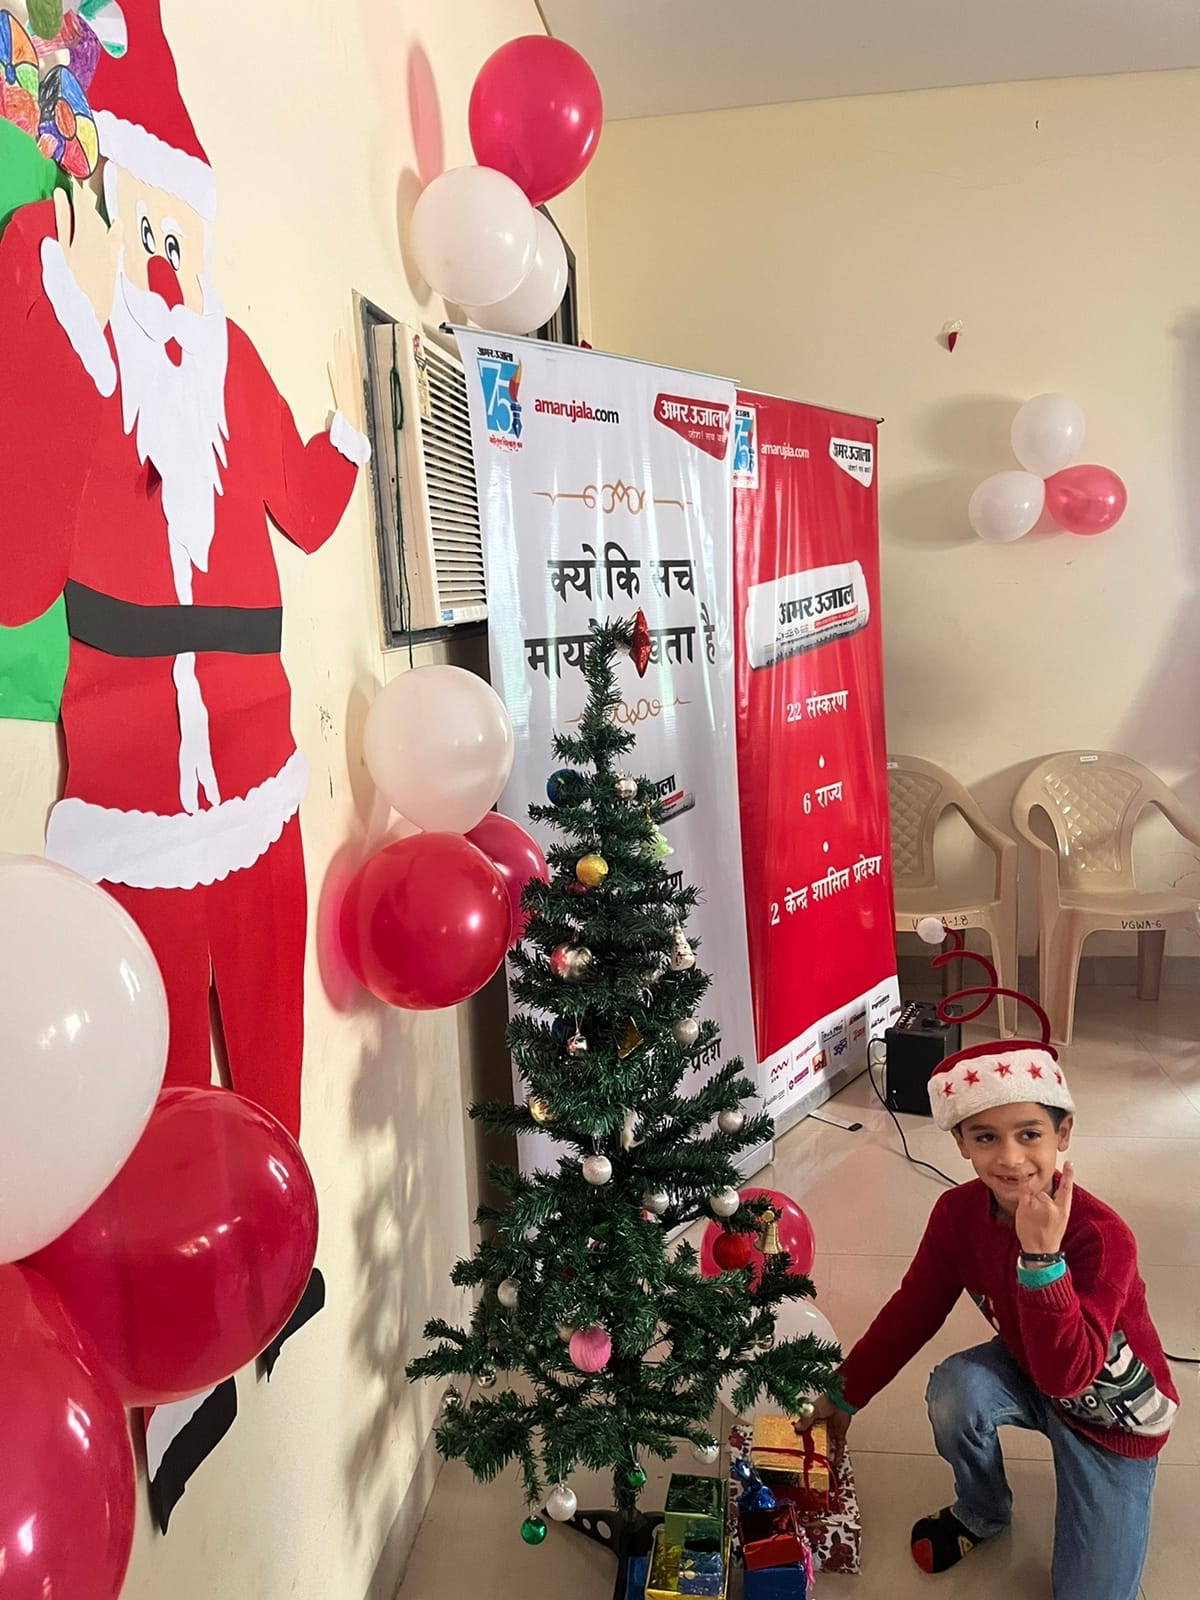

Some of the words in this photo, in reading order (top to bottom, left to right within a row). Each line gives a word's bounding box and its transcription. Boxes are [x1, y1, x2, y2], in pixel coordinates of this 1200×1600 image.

[534, 398, 620, 424] amarujala.com
[660, 400, 688, 422] अमर
[689, 405, 727, 428] उजाला
[760, 442, 810, 460] amarujala.com
[833, 442, 848, 459] अमर
[848, 446, 871, 462] उजाला
[778, 596, 814, 625] अमर
[700, 602, 716, 665] है
[786, 702, 802, 723] 22
[805, 690, 848, 719] संस्करण
[802, 792, 812, 815] 6
[815, 781, 843, 808] राज्य
[770, 902, 781, 926] 2
[783, 887, 809, 915] केन्द्र
[811, 866, 850, 902] शासित
[852, 853, 882, 884] प्रदेश
[911, 915, 968, 930] VA-18
[1121, 919, 1162, 929] VGWA-6
